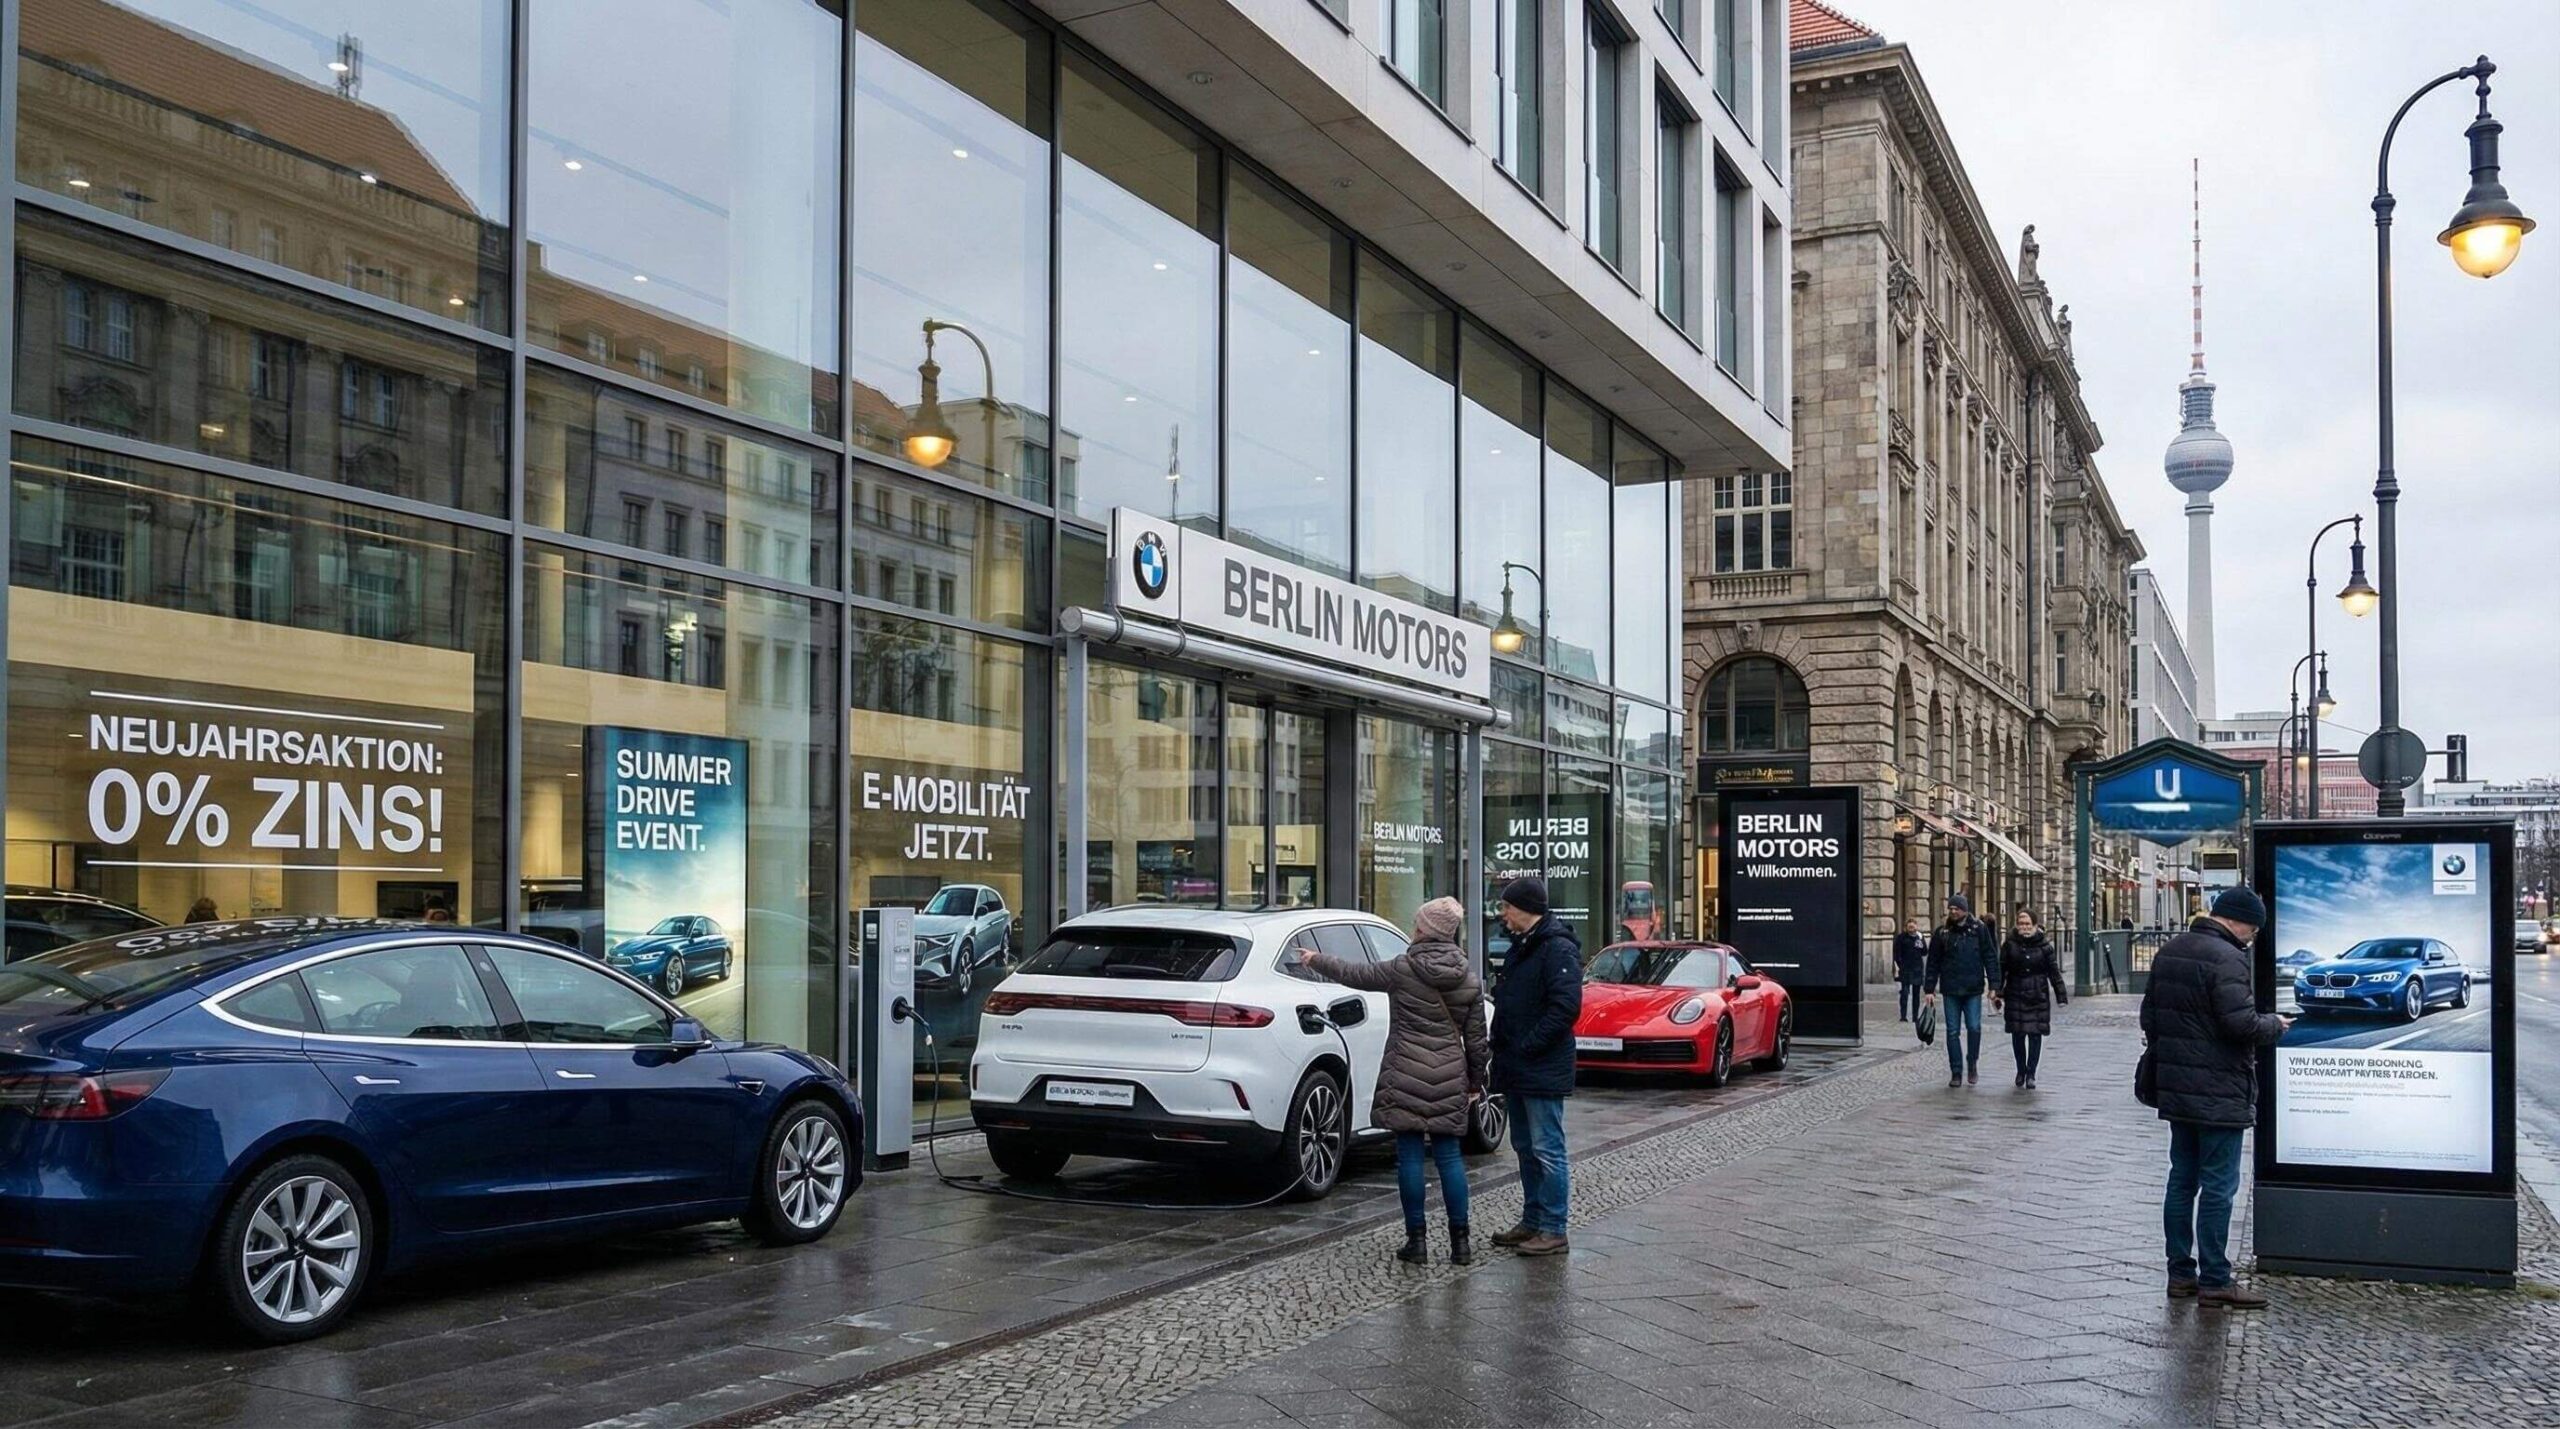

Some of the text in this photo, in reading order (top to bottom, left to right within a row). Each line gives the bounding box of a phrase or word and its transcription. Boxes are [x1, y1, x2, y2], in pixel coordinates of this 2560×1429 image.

[1224, 557, 1467, 679] BERLIN MOTORS
[90, 714, 443, 775] NEUJAHRSAKTION:
[617, 748, 732, 785] SUMMER
[2155, 768, 2182, 800] U
[88, 768, 443, 852] 0% ZINS!
[617, 784, 696, 817] DRIVE
[863, 772, 1031, 819] E-MOBILITÄT
[617, 821, 706, 852] EVENT.
[904, 822, 993, 861] JETZT.
[1737, 814, 1823, 834] BERLIN
[1737, 838, 1840, 858] MOTORS
[1746, 864, 1837, 879] Willkommen.
